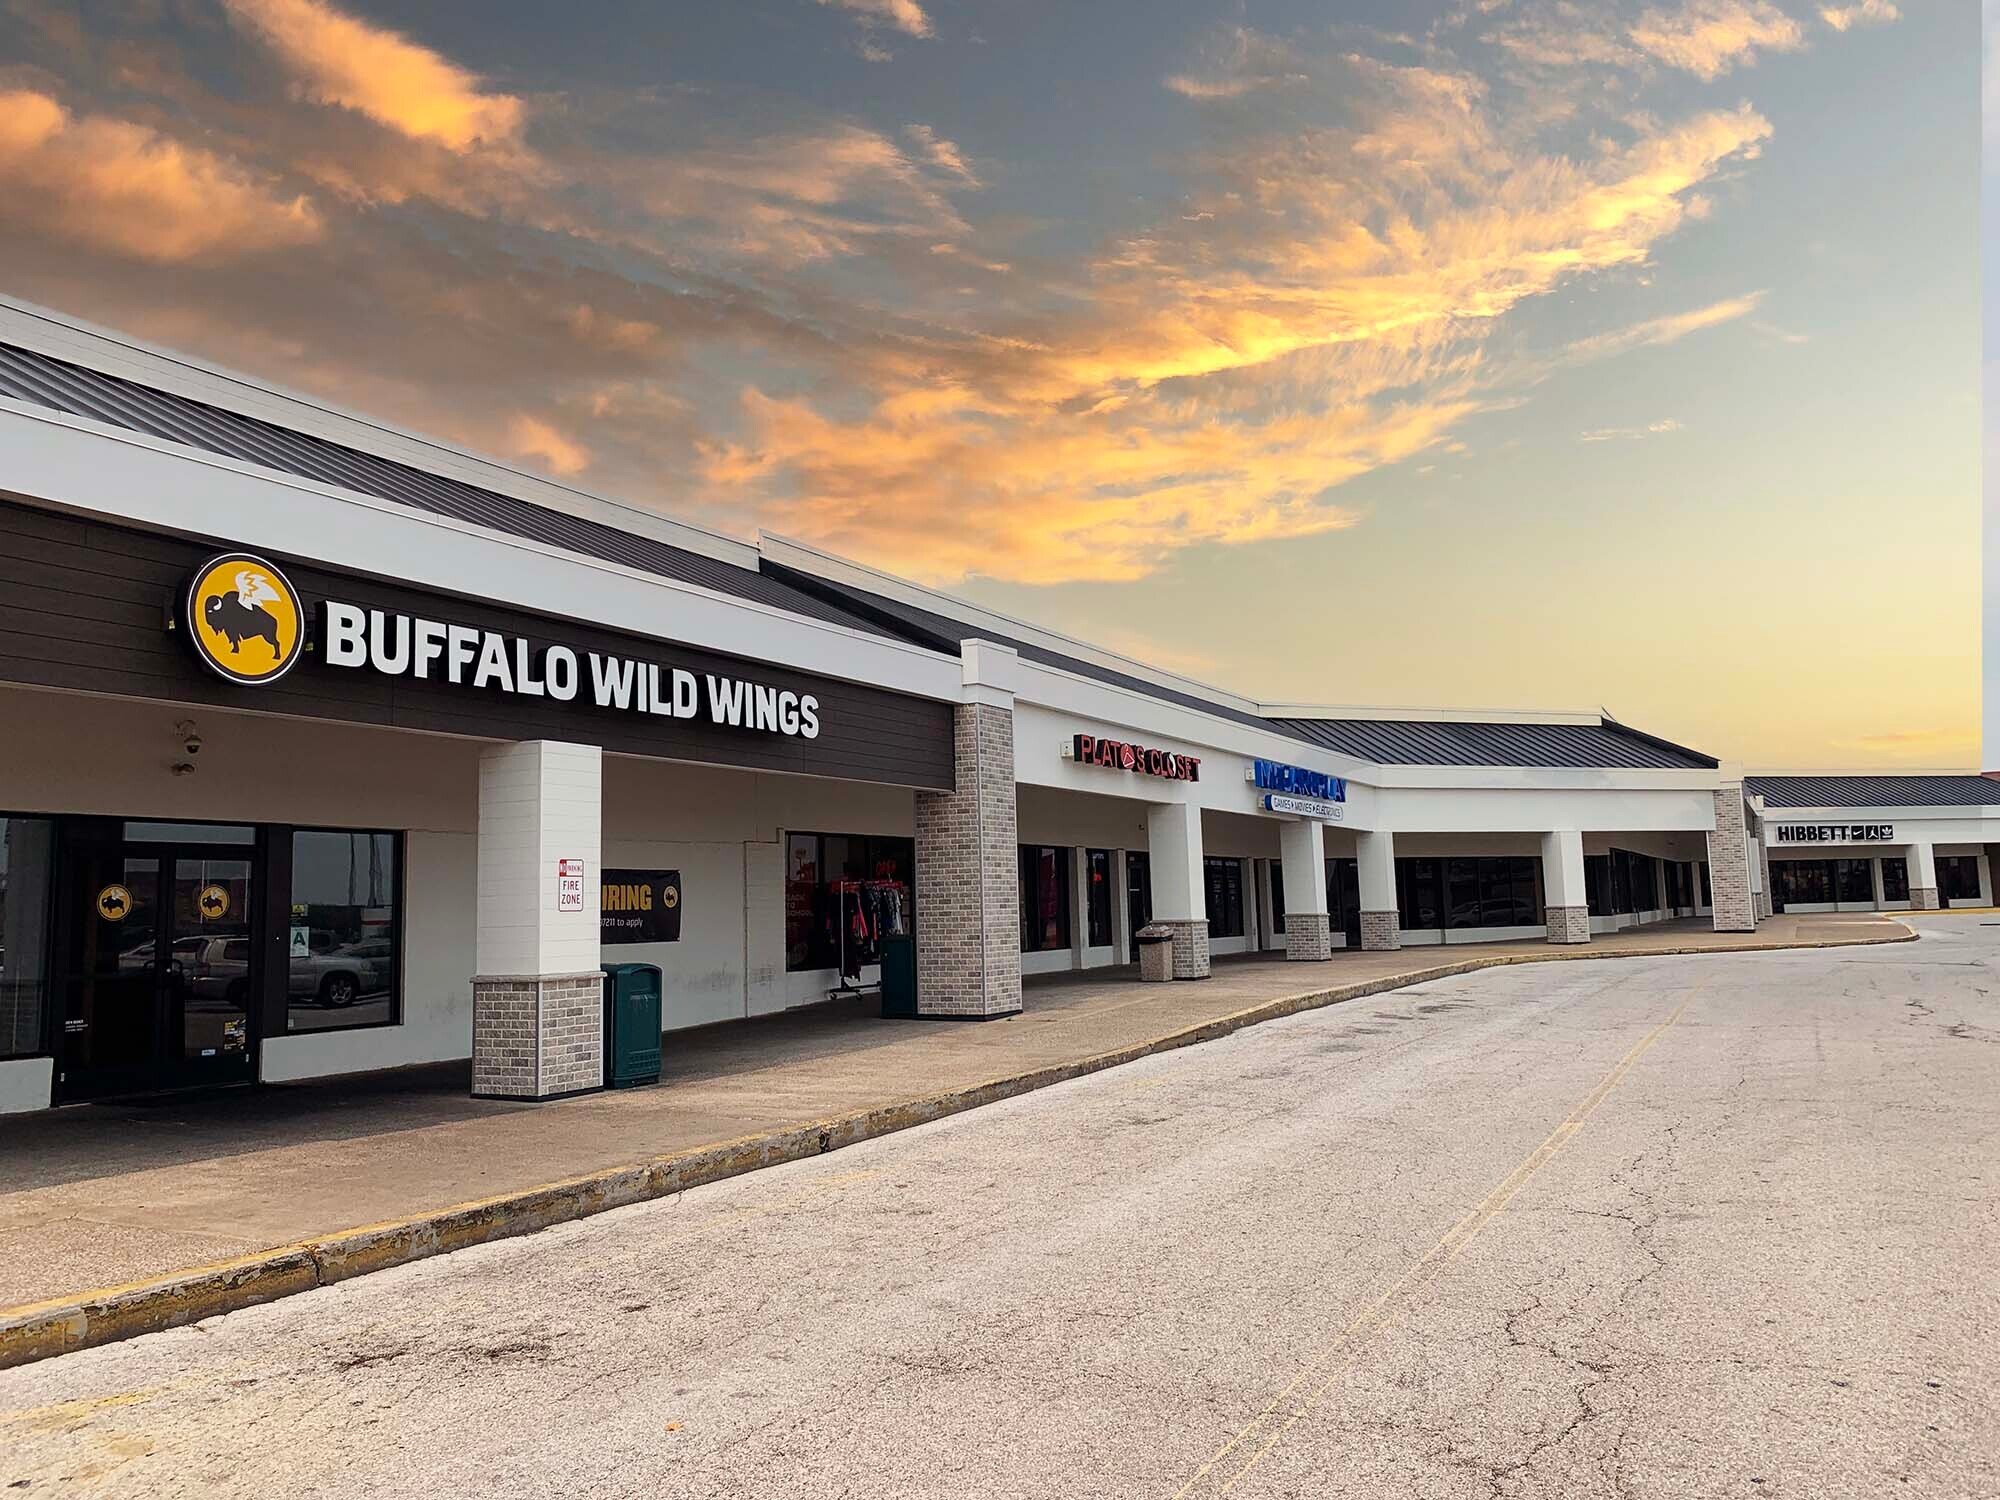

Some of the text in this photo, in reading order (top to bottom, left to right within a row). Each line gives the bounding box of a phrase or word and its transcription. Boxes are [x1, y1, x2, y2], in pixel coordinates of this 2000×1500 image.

[326, 601, 820, 740] BUFFALO WILD WINGS
[1148, 748, 1200, 782] CLOSET
[1777, 825, 1849, 841] HIBBETT
[562, 880, 580, 891] FIRE
[561, 894, 581, 905] ZONE
[617, 919, 625, 927] to
[626, 917, 643, 928] apply
